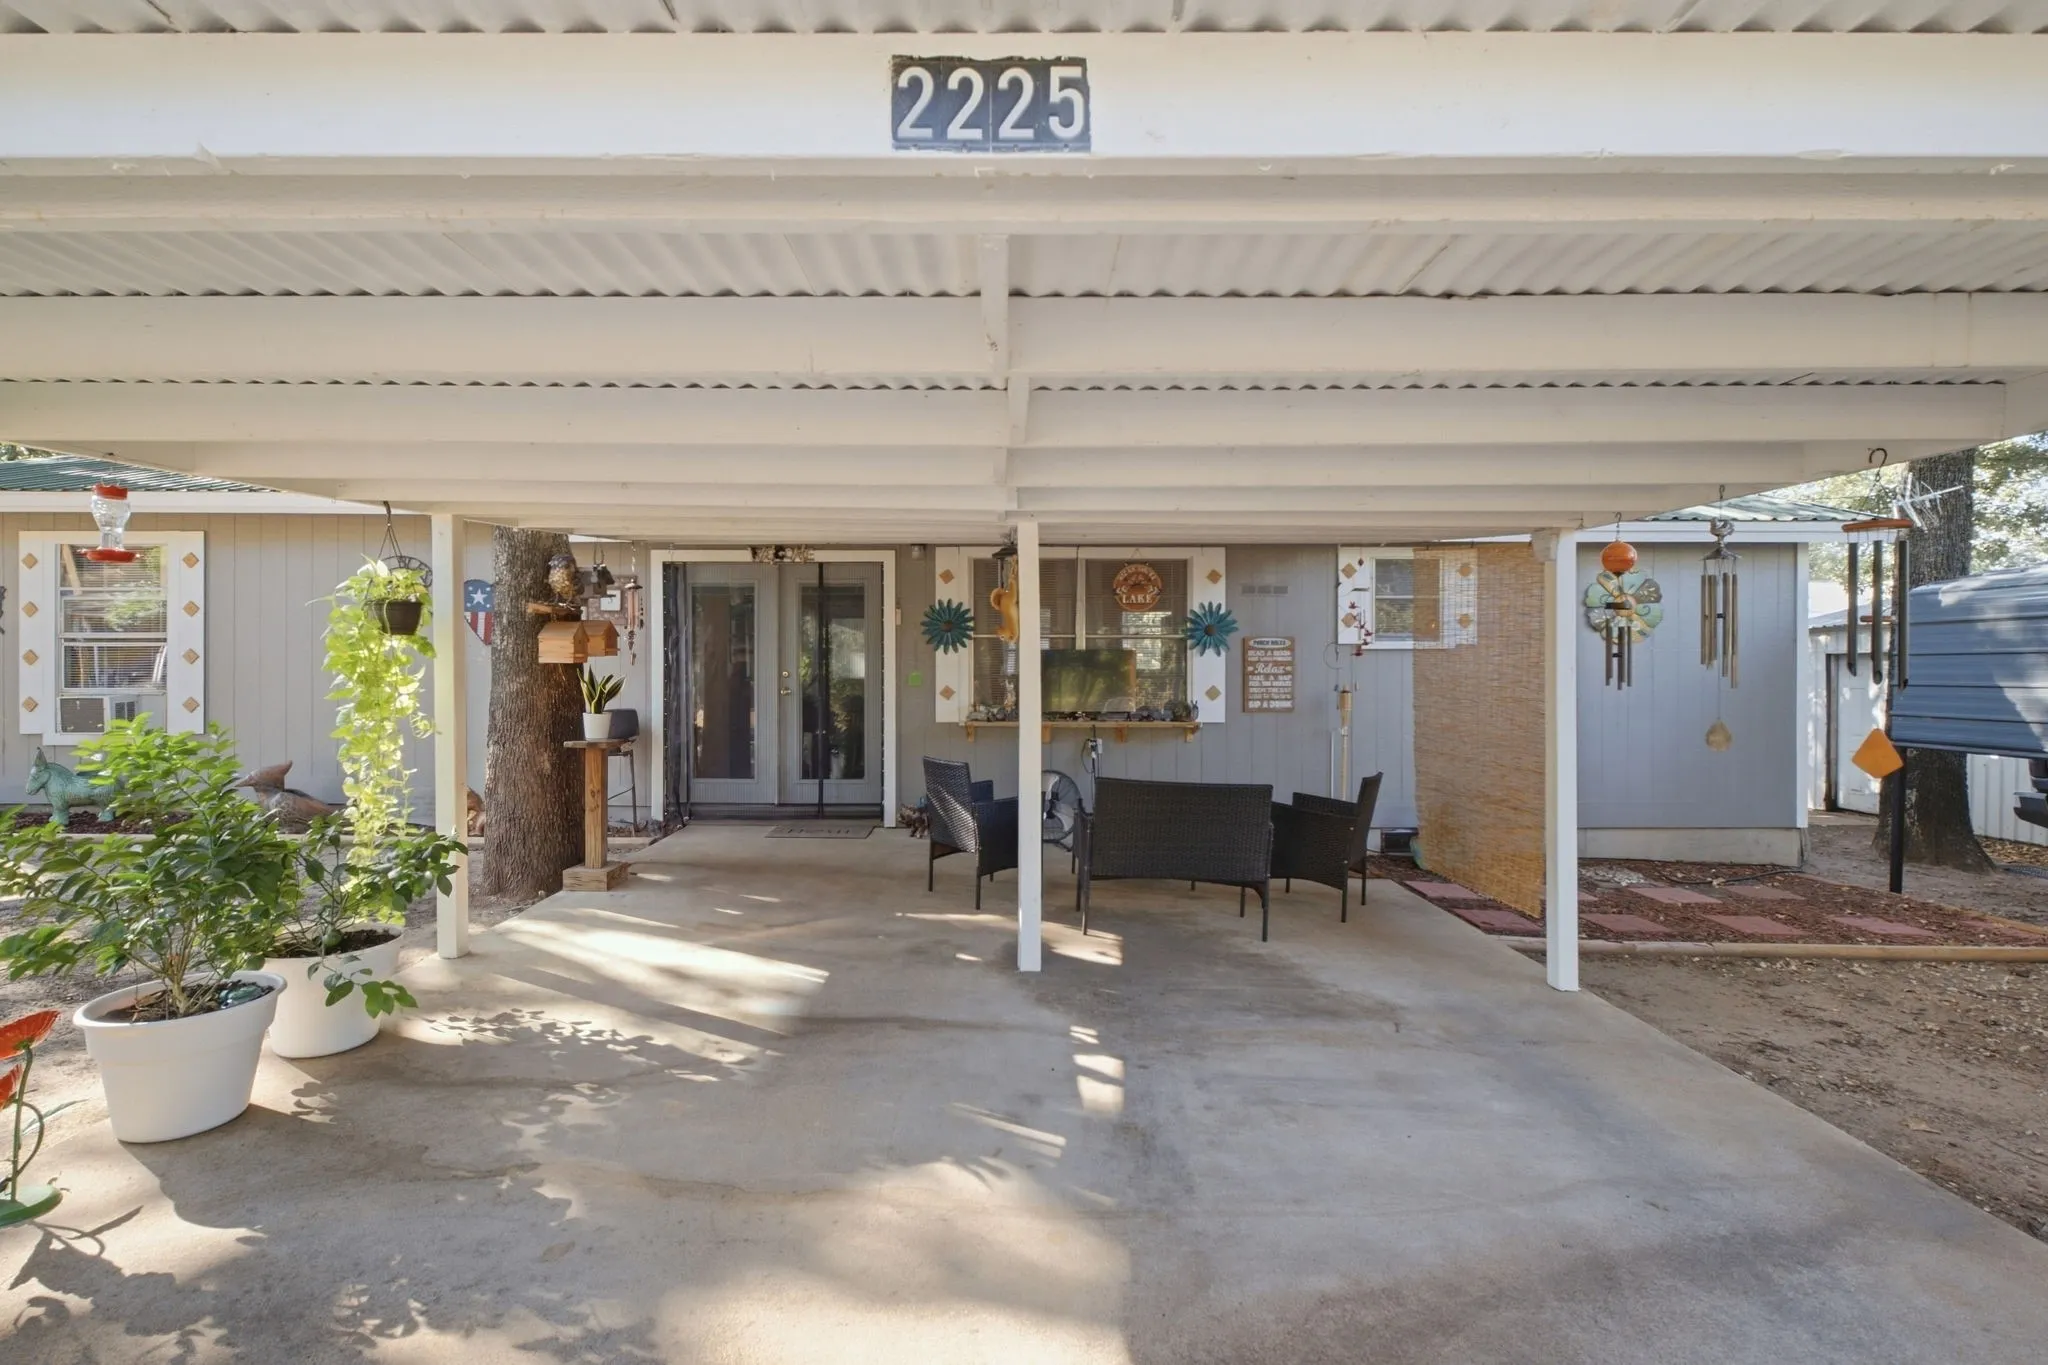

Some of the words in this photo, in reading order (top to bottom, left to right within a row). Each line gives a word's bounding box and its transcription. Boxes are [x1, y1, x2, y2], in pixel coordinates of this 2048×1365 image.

[897, 66, 1085, 140] 2225
[1122, 594, 1152, 603] LAKE
[1255, 662, 1285, 673] Relax
